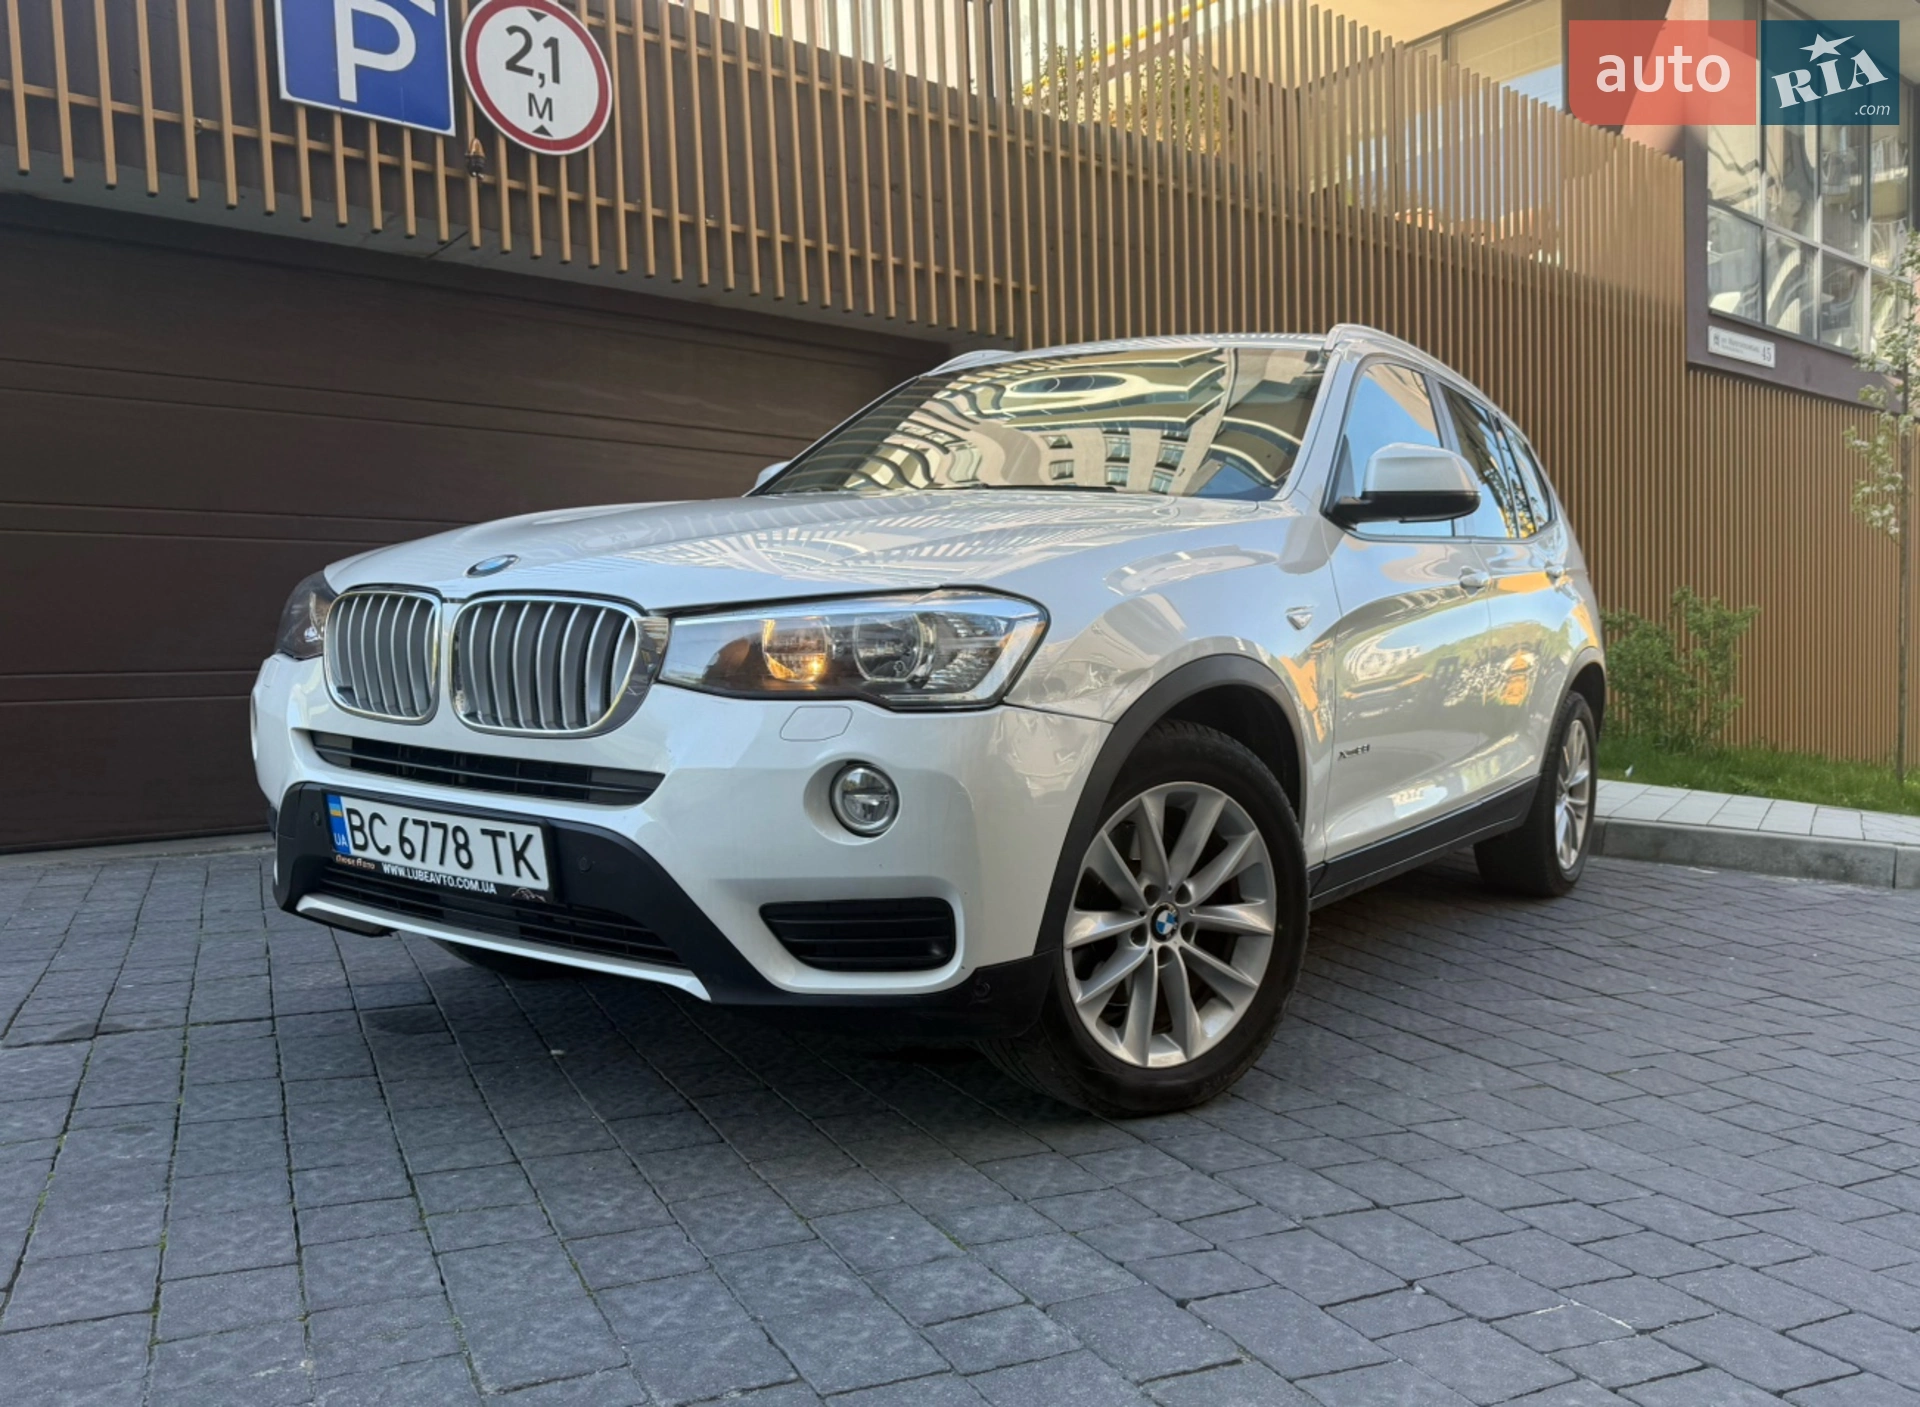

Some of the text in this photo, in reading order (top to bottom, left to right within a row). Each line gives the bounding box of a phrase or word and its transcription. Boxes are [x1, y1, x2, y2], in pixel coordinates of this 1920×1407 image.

[334, 0, 416, 103] P
[505, 25, 561, 88] 2,1
[334, 832, 349, 847] UA
[346, 807, 541, 881] BC 6778 TK
[381, 862, 497, 895] WWW.LUBEAVTO.COM.UA
